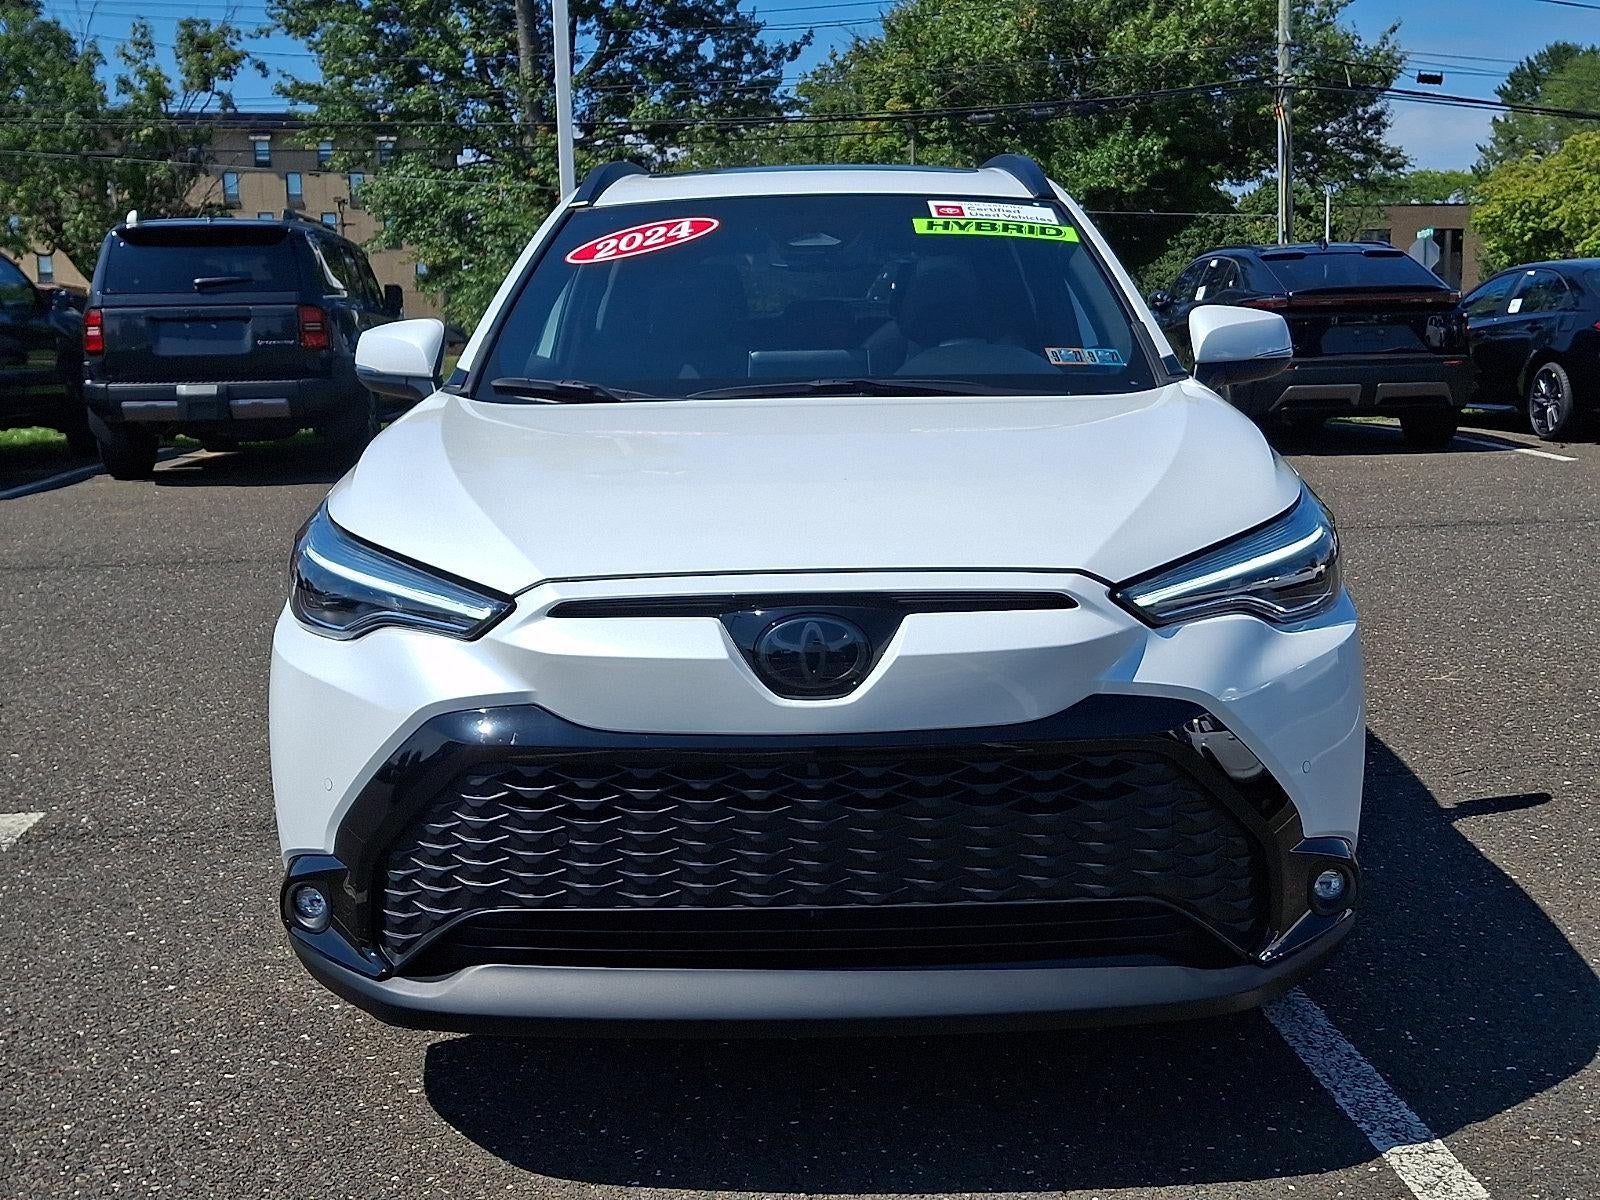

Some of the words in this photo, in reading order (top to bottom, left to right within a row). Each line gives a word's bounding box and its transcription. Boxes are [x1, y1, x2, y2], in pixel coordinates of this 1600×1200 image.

[967, 206, 1021, 214] Certified
[969, 211, 1000, 219] Used
[1002, 213, 1053, 223] Vehicles
[926, 220, 1065, 238] HYBRID
[594, 220, 694, 259] 2024
